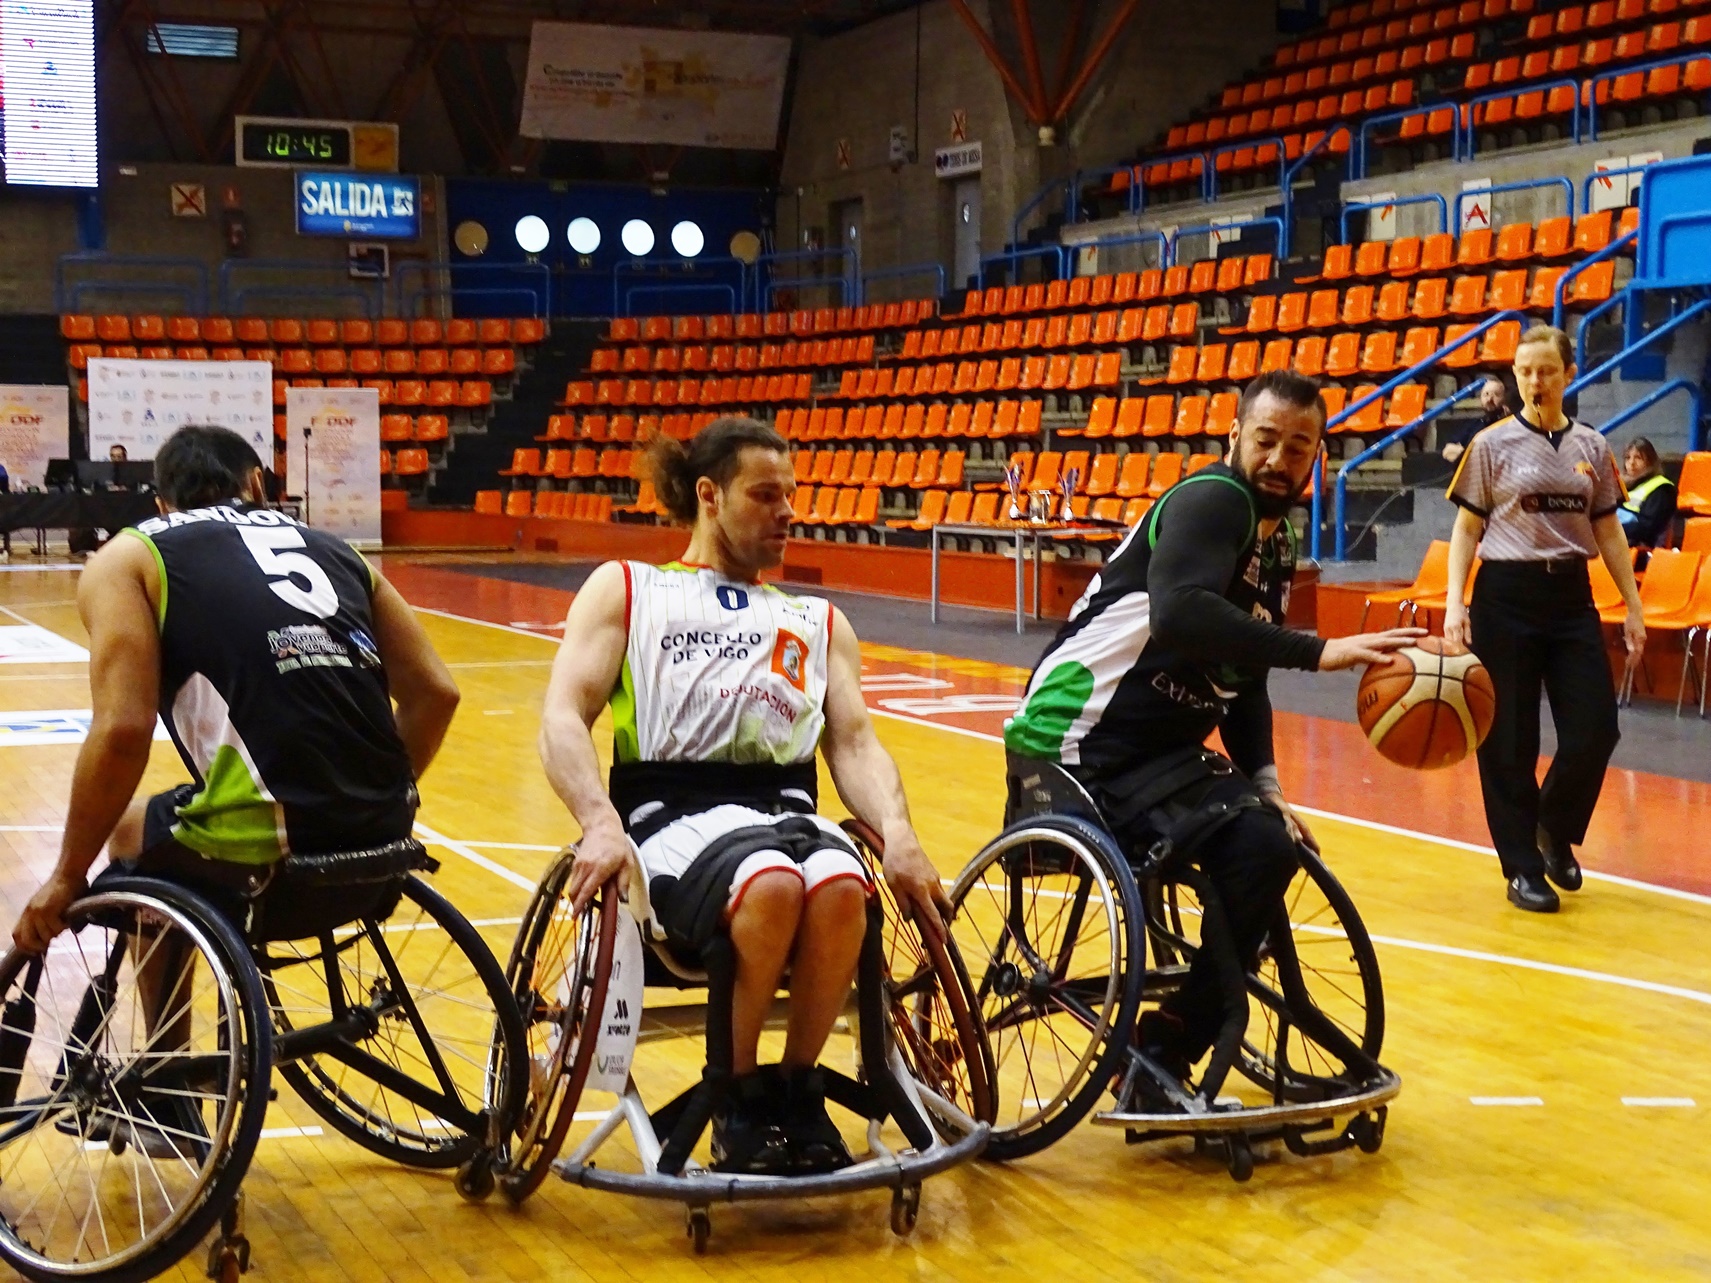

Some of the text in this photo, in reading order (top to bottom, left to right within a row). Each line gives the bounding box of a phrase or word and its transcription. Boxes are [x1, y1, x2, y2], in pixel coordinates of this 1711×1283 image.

[267, 133, 332, 157] 10:45
[302, 180, 388, 218] SALIDA
[236, 525, 339, 620] 5
[661, 631, 762, 650] CONCELLO
[673, 646, 749, 664] DE VIGO
